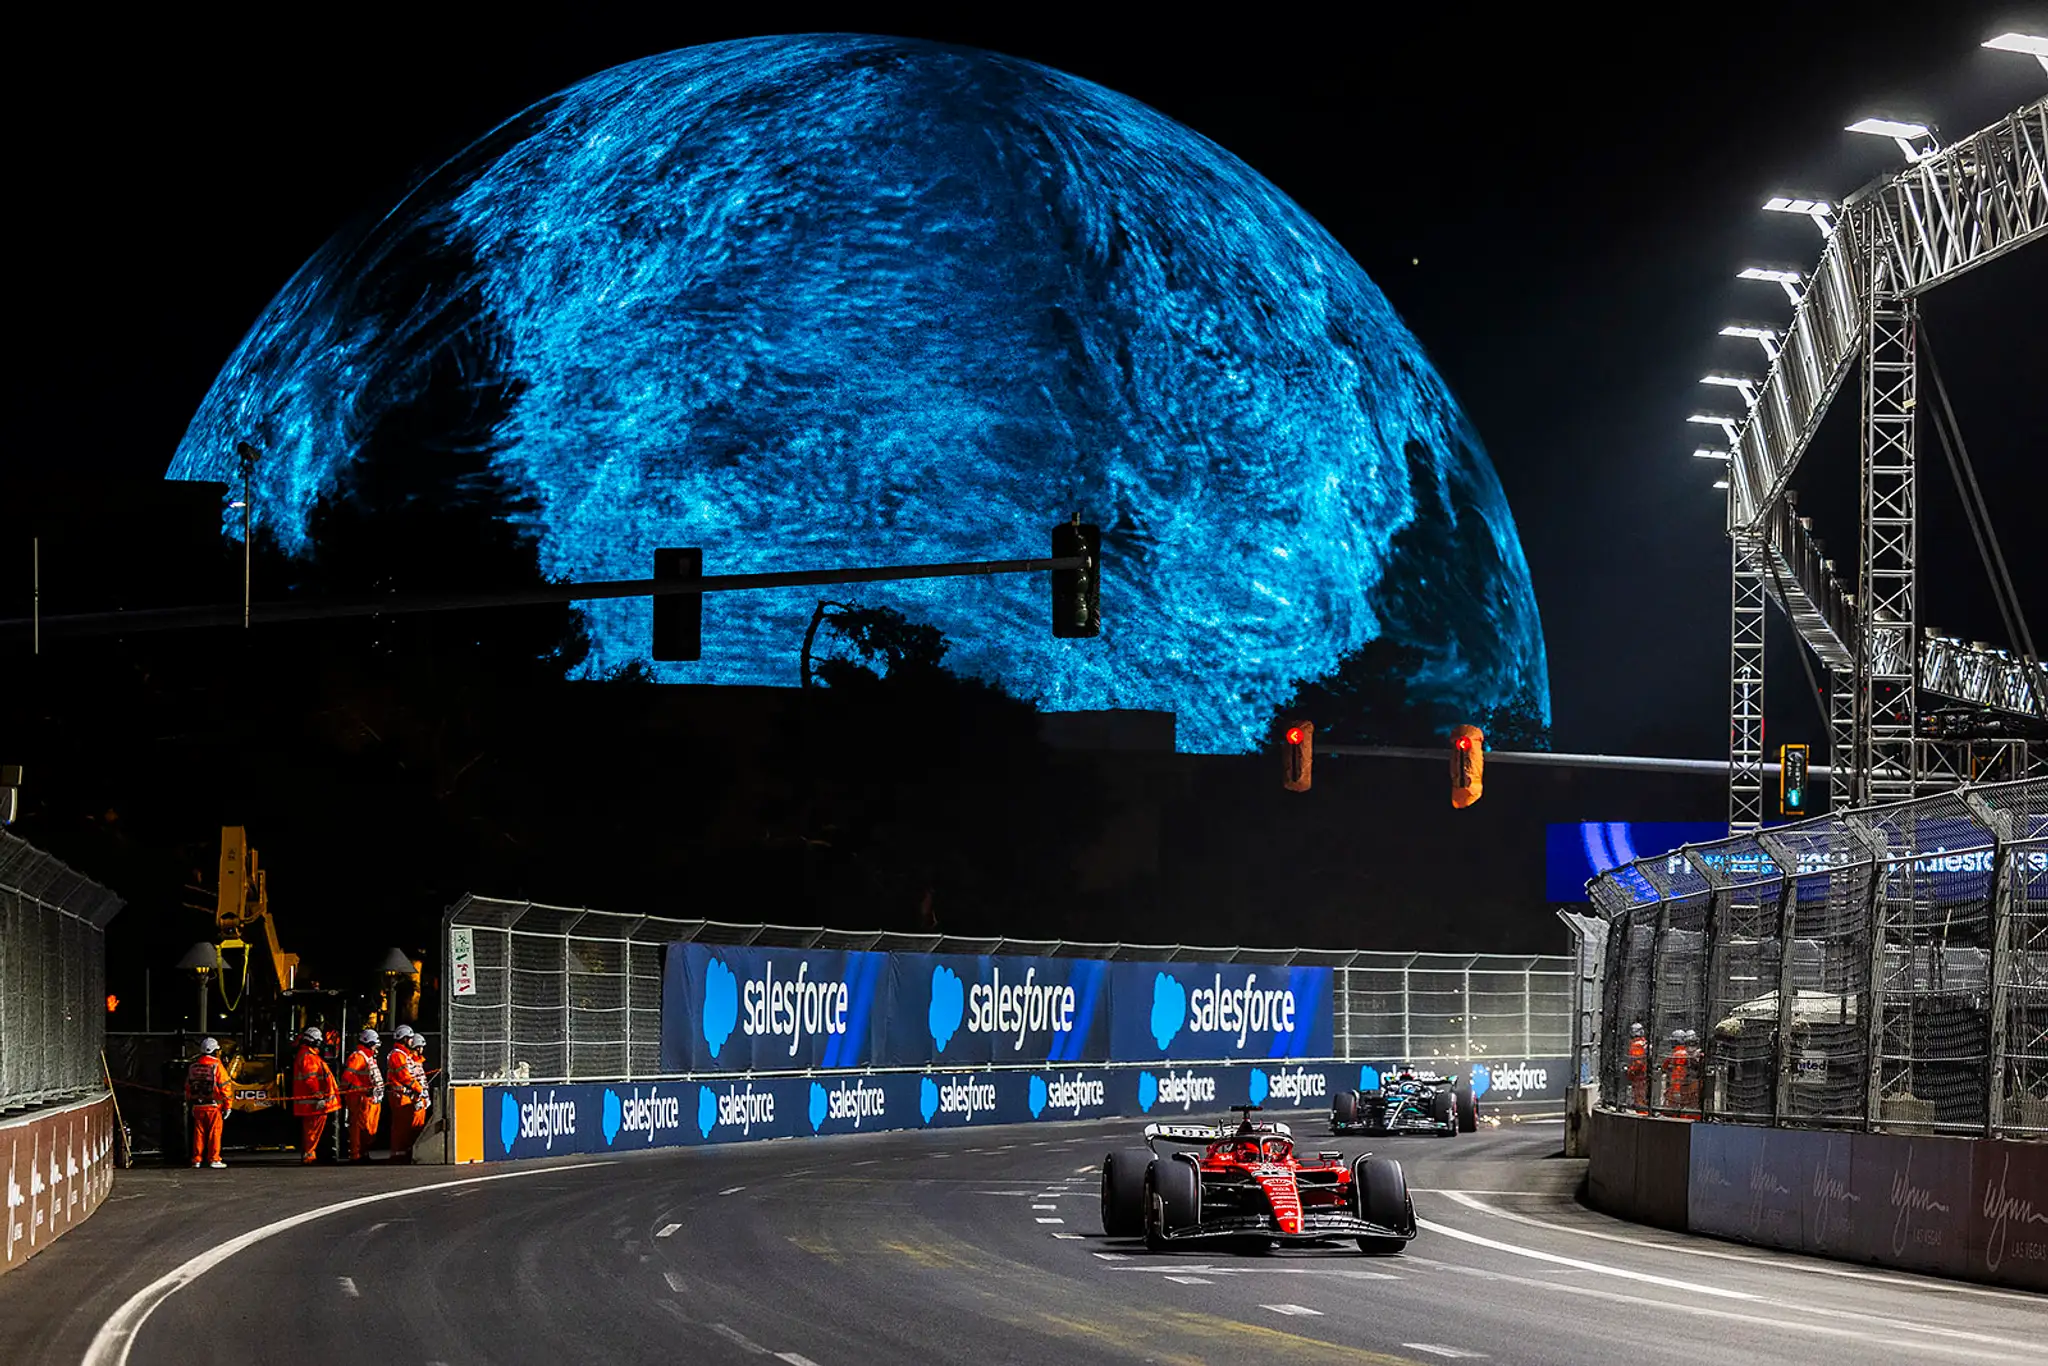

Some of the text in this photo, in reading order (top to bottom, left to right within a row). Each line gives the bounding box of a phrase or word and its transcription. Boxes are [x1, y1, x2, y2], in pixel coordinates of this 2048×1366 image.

[744, 961, 847, 1056] salesforce
[968, 968, 1074, 1050] salesforce
[1190, 973, 1295, 1049] salesforce
[236, 1091, 266, 1100] JCB
[830, 1079, 884, 1128] salesforce
[941, 1076, 995, 1120] salesforce
[1049, 1072, 1104, 1116] salesforce
[1159, 1070, 1215, 1110] salesforce
[1270, 1067, 1325, 1105] salesforce
[1491, 1062, 1547, 1098] salesforce
[521, 1090, 575, 1149] salesforce
[623, 1087, 678, 1142] salesforce
[719, 1083, 774, 1133] salesforce
[1891, 1144, 1946, 1257] Wynn
[1983, 1152, 2048, 1272] Wynn
[2011, 1241, 2048, 1260] LAS VEGAS
